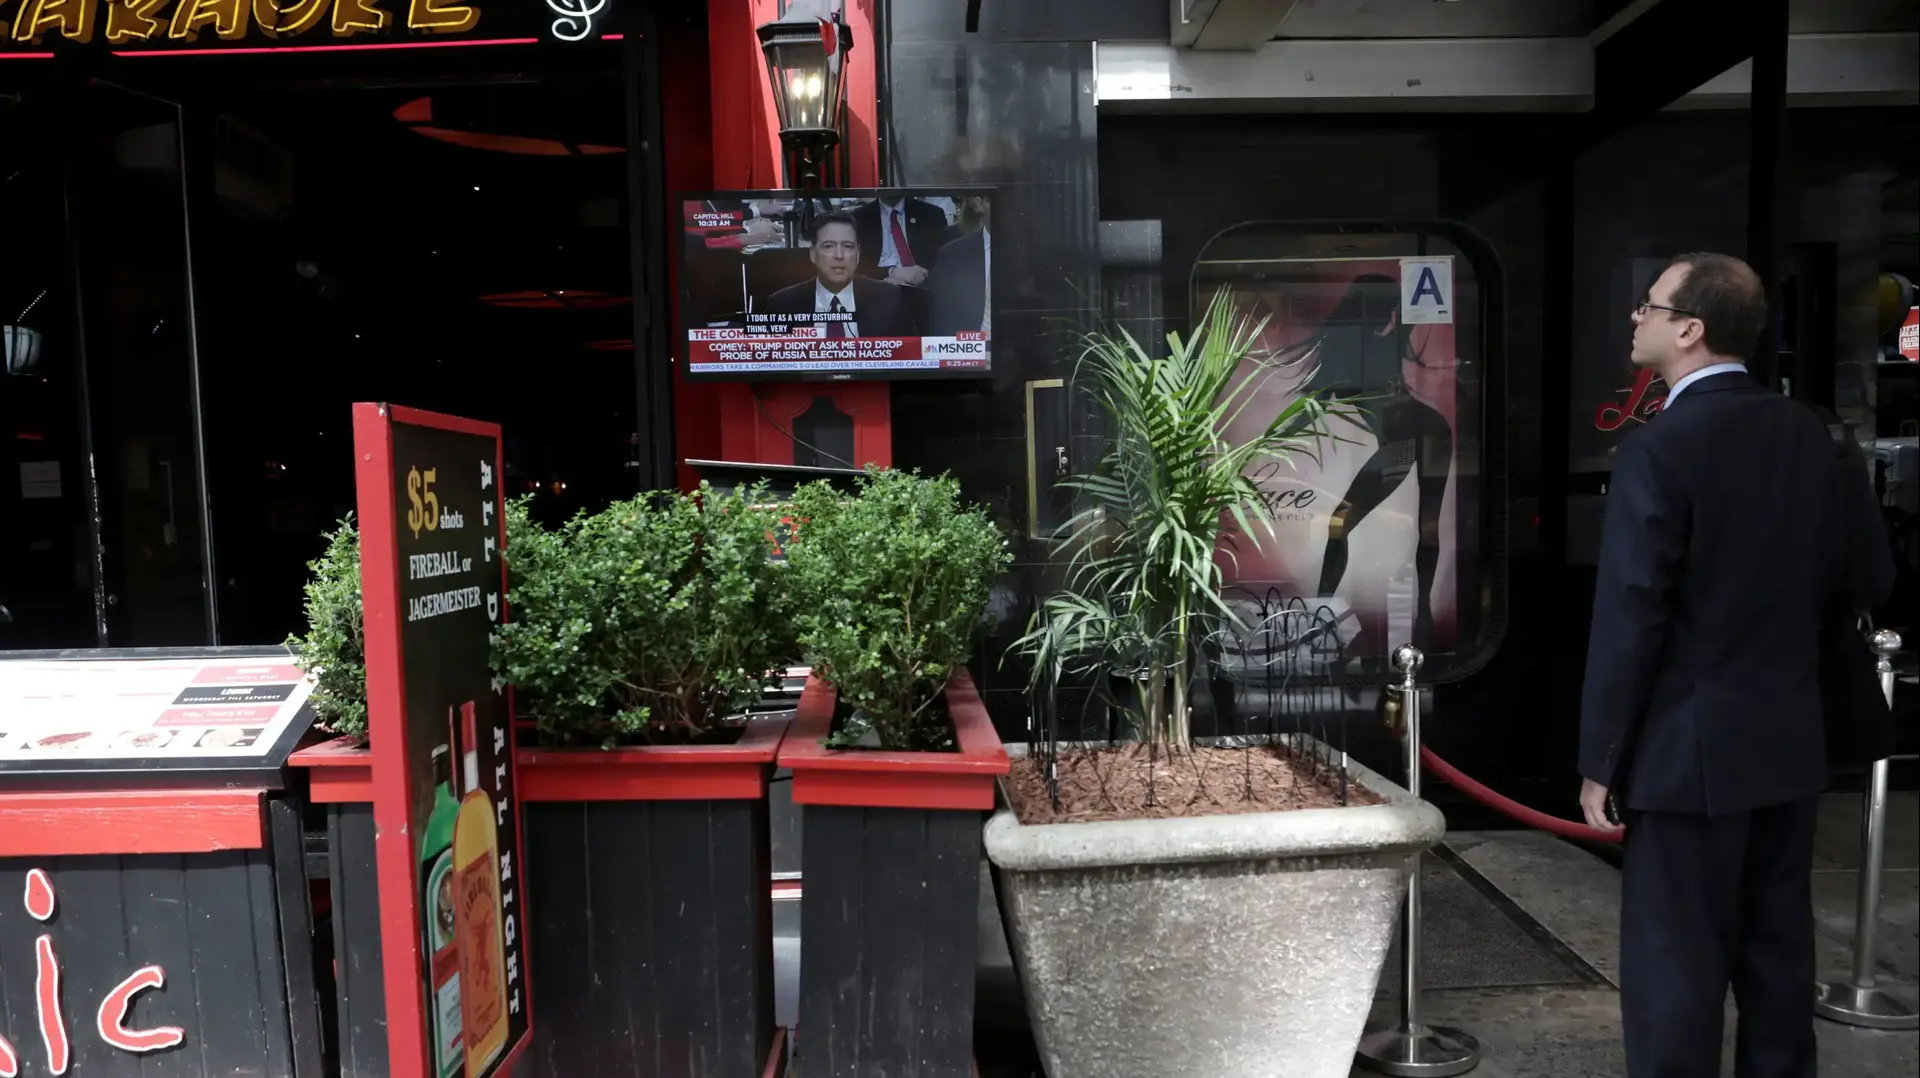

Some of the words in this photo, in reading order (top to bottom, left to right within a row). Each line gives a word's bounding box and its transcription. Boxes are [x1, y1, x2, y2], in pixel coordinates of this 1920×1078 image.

[0, 0, 481, 42] ARAOKE
[1410, 267, 1444, 305] A
[693, 330, 716, 339] THE
[747, 325, 769, 333] THING,
[770, 325, 788, 333] VERY
[751, 314, 769, 322] TOOK
[769, 314, 777, 322] IT
[777, 314, 787, 322] AS
[793, 313, 811, 321] VERY
[812, 313, 853, 321] DISTURBING
[709, 343, 746, 352] COMEY:
[748, 342, 782, 351] TRUMP
[784, 341, 817, 350] DIDN'T
[819, 341, 839, 350] ASK
[841, 341, 856, 349] ME
[858, 341, 872, 349] TO
[875, 340, 903, 348] DROP
[939, 343, 982, 353] MSNBC
[960, 332, 981, 340] LIVE
[720, 351, 753, 360] PROBE
[755, 351, 769, 360] OF
[772, 351, 807, 359] RUSSIA
[809, 350, 856, 359] ELECTION
[859, 349, 892, 358] HACKS
[407, 464, 439, 540] $5
[440, 506, 464, 529] shots
[480, 460, 495, 562] ALL
[409, 551, 461, 580] FIREBALL
[462, 556, 472, 572] or
[408, 586, 482, 622] JAGERMEISTER
[486, 591, 506, 696] DY
[493, 726, 508, 826] ALL
[500, 851, 520, 1015] NIGHT
[0, 868, 185, 1077] ic
